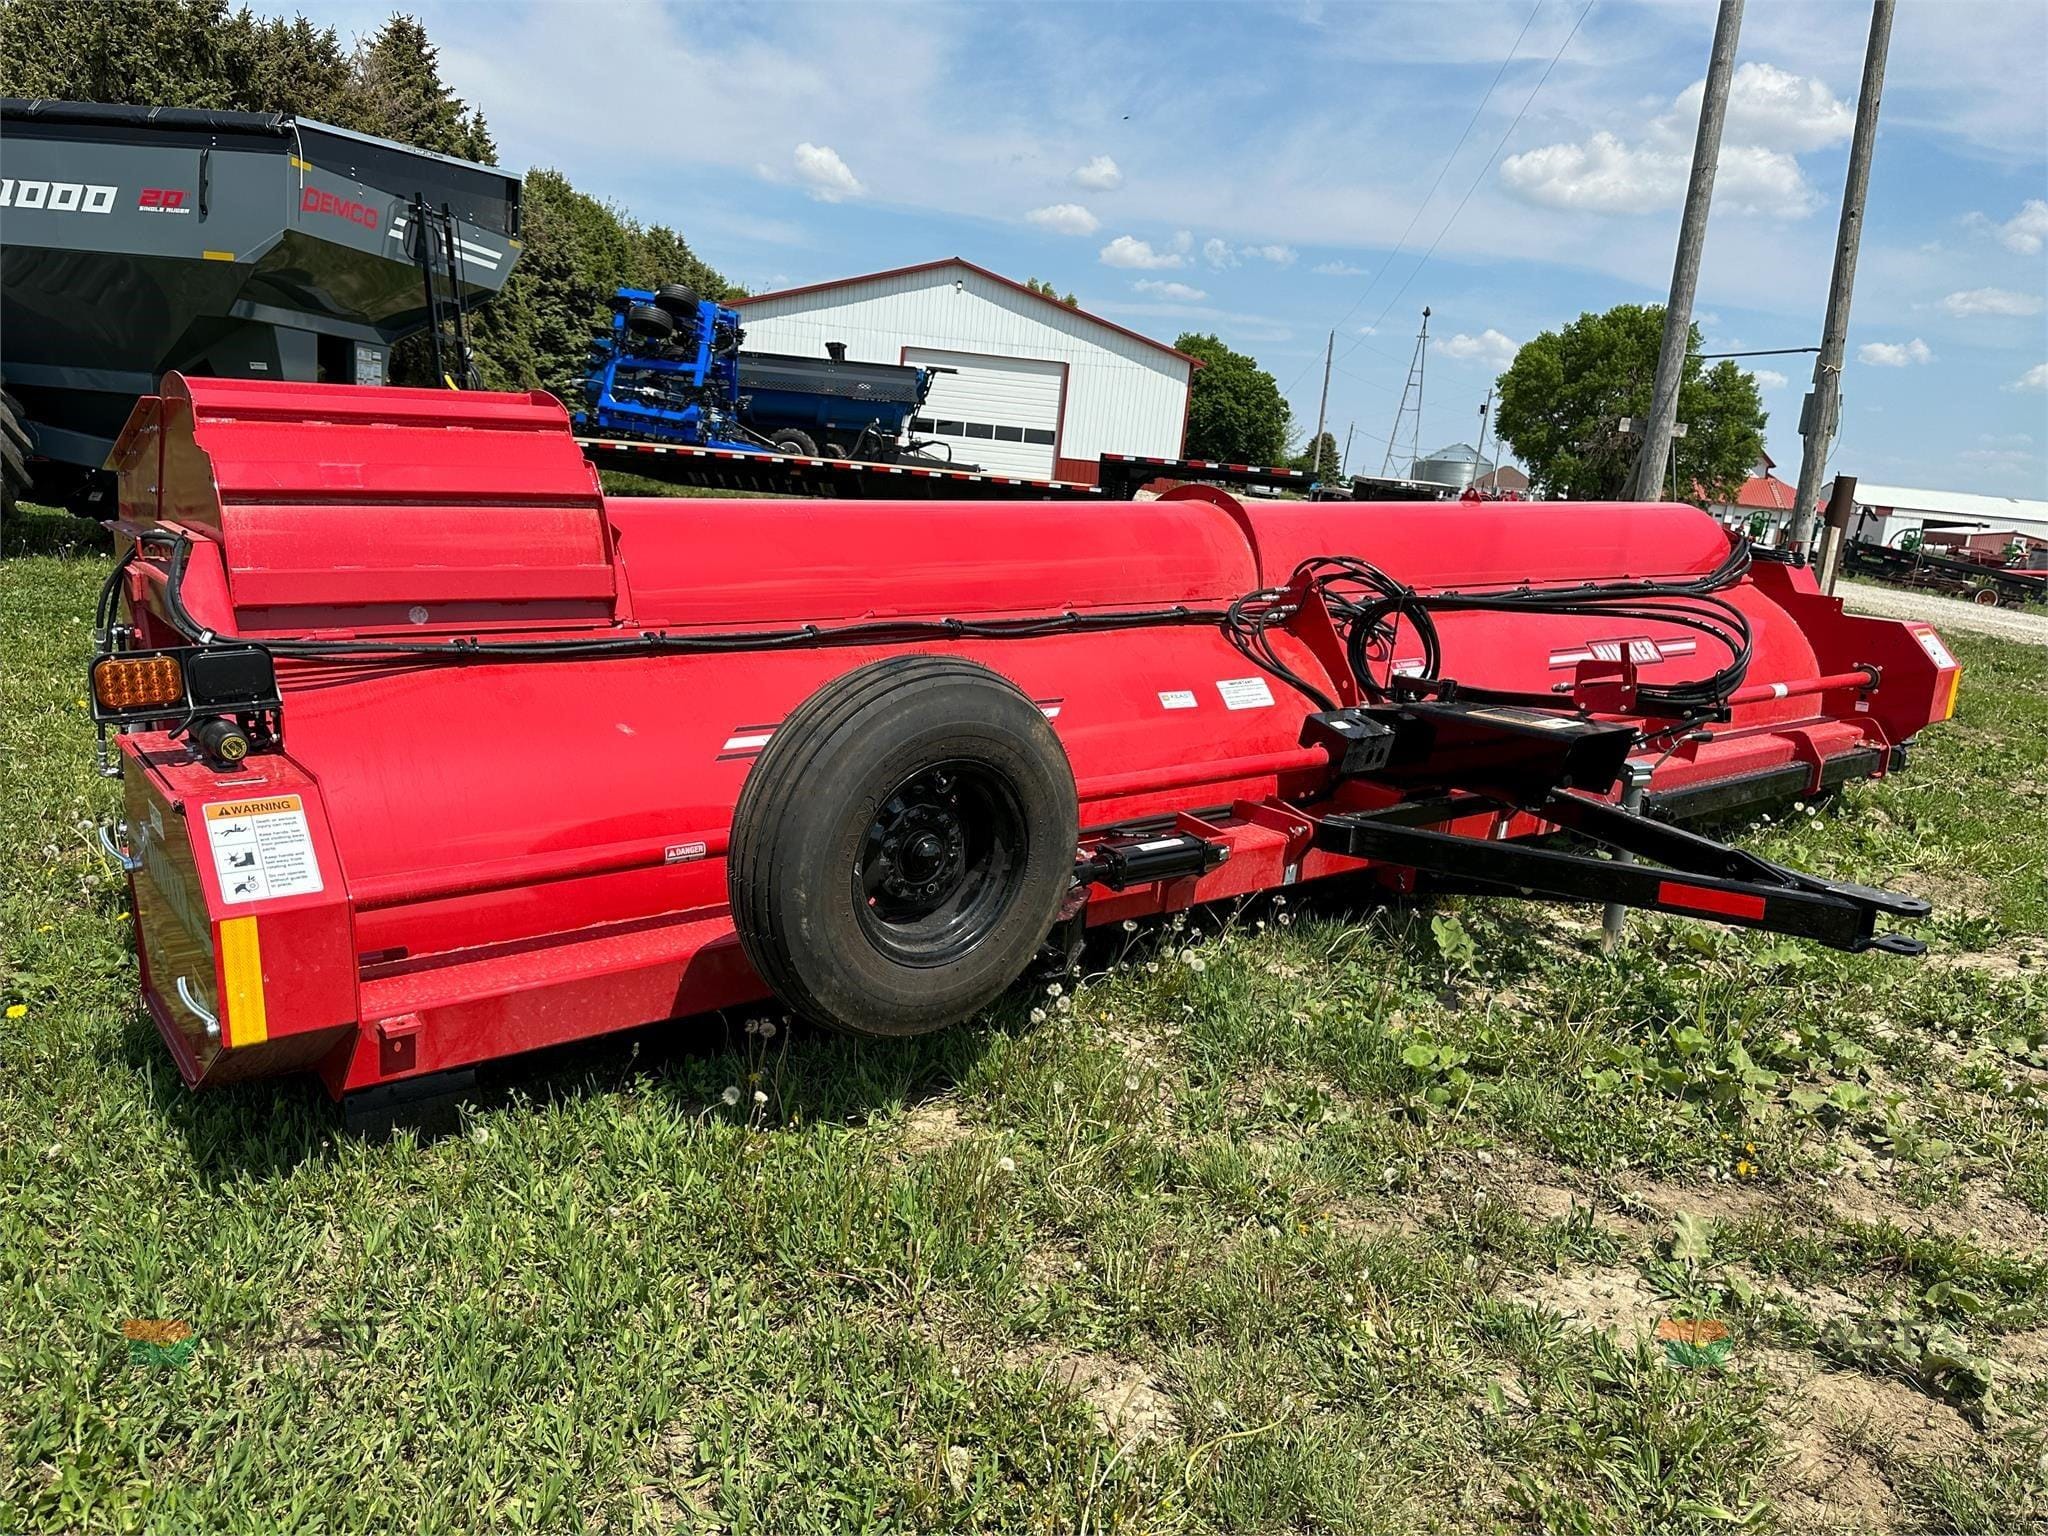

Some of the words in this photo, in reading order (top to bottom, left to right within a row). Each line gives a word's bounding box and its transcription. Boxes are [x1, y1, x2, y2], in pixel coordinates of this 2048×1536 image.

[0, 179, 118, 214] 1000
[302, 186, 378, 230] DEMCO
[1591, 640, 1660, 662] HINKER
[231, 800, 290, 814] WARNING
[676, 845, 704, 856] DANGER
